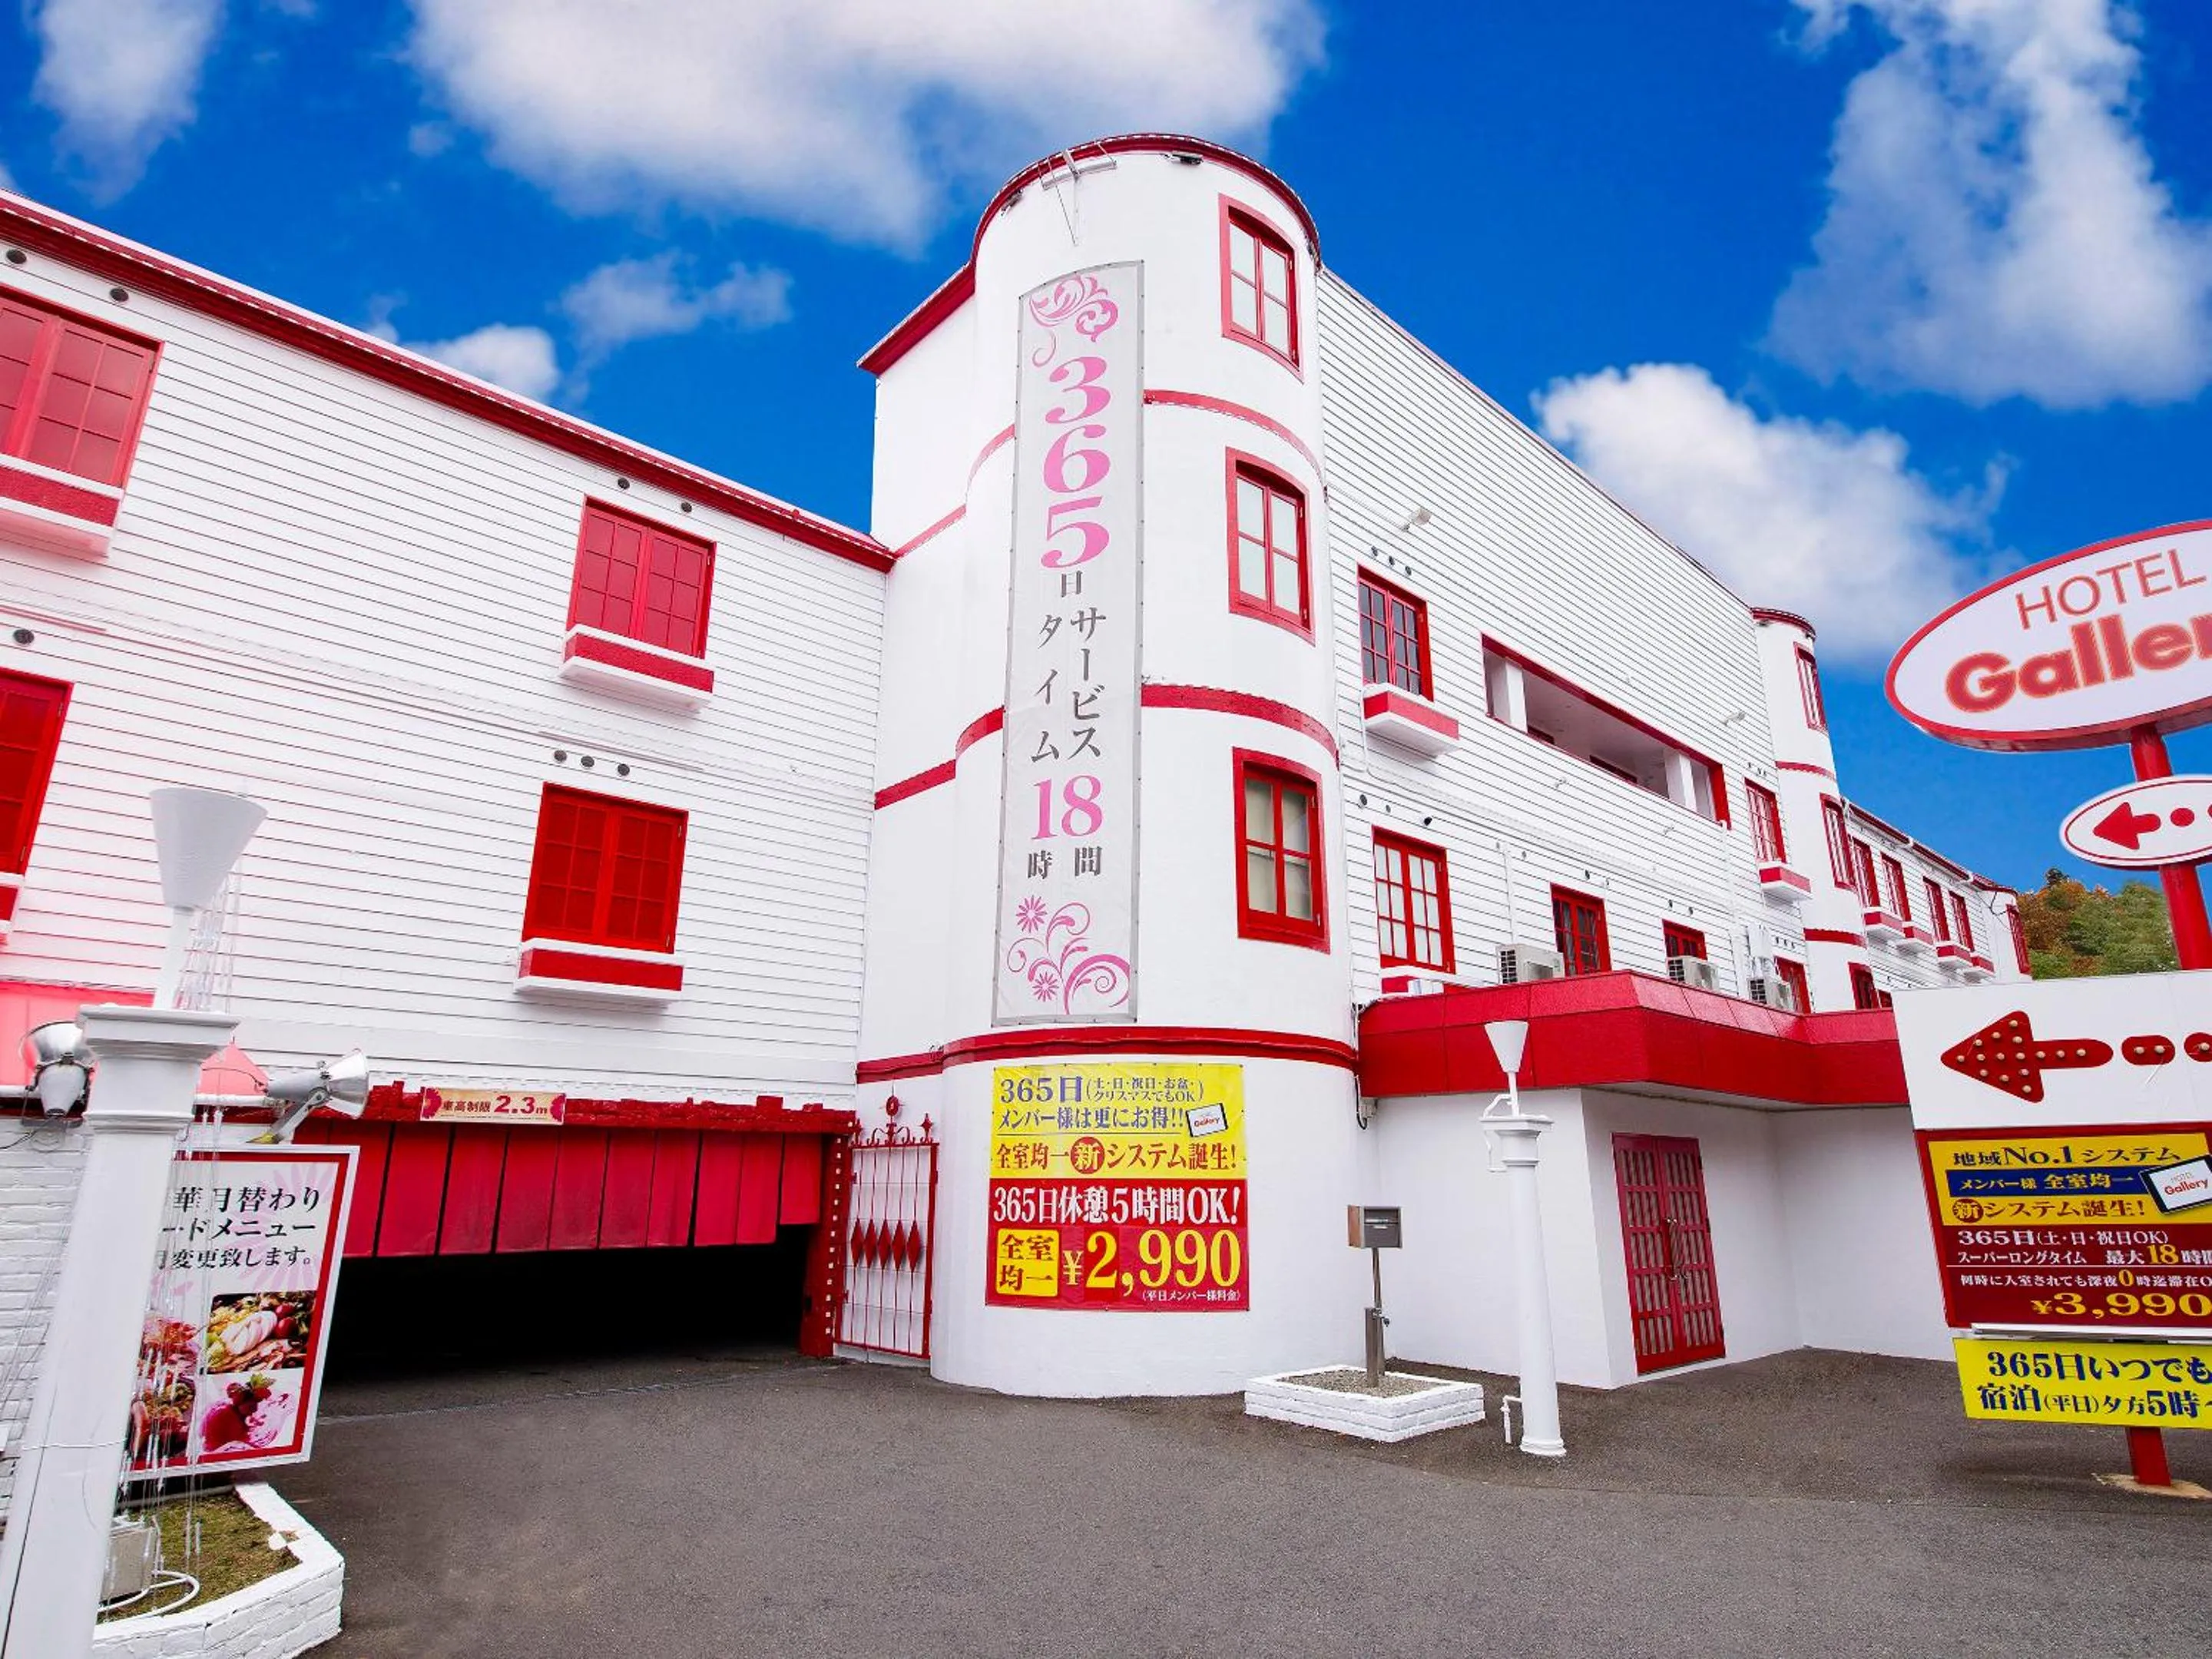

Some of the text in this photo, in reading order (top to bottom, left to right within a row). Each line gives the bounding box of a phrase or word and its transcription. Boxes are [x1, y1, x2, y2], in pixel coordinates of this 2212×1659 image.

[2015, 548, 2207, 630] HOTEL
[1030, 614, 1063, 763] タイム
[1068, 607, 1107, 760] サービス
[1030, 774, 1104, 840] 18
[1027, 846, 1103, 879] 時間
[999, 1075, 1083, 1103] 365日
[443, 1094, 548, 1114] 車高制限 2.3m
[998, 1106, 1184, 1130] メンバー様は更にお得!!
[1960, 1173, 2134, 1190] メンバー様 全室均一
[2164, 1179, 2208, 1195] Gallery
[993, 1186, 1240, 1225] 365日休憩5時間OK!
[1002, 1234, 1055, 1260] 全室
[1959, 1251, 2088, 1264] スーパーロングタイム
[1063, 1229, 1241, 1297] ¥2,990
[999, 1265, 1055, 1292] 均一
[2031, 1293, 2212, 1319] ¥3,990
[1987, 1352, 2212, 1384] 365日いつでも
